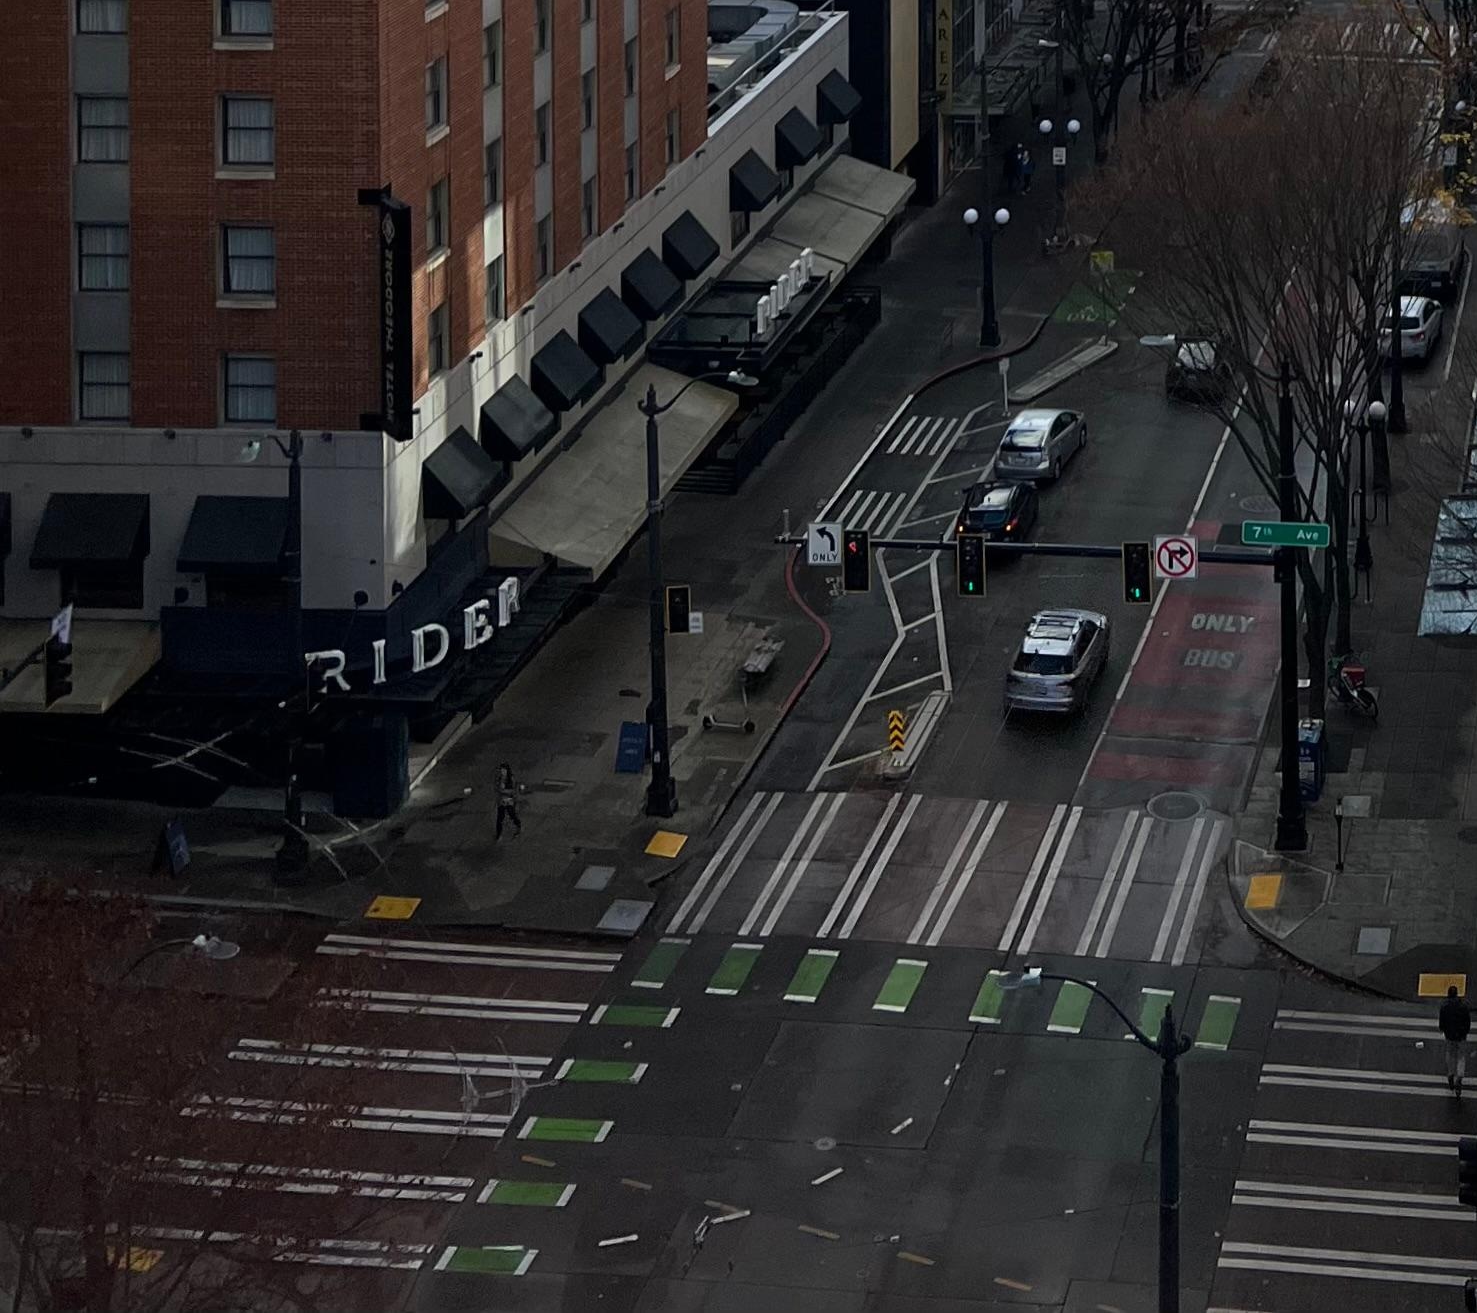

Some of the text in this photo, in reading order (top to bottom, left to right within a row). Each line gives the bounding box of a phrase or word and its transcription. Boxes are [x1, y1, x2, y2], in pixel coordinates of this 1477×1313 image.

[1296, 529, 1319, 541] Ave
[812, 553, 838, 562] ONLY
[1191, 612, 1255, 633] ONLY
[304, 576, 521, 695] RIDER
[1184, 648, 1236, 669] BUS
